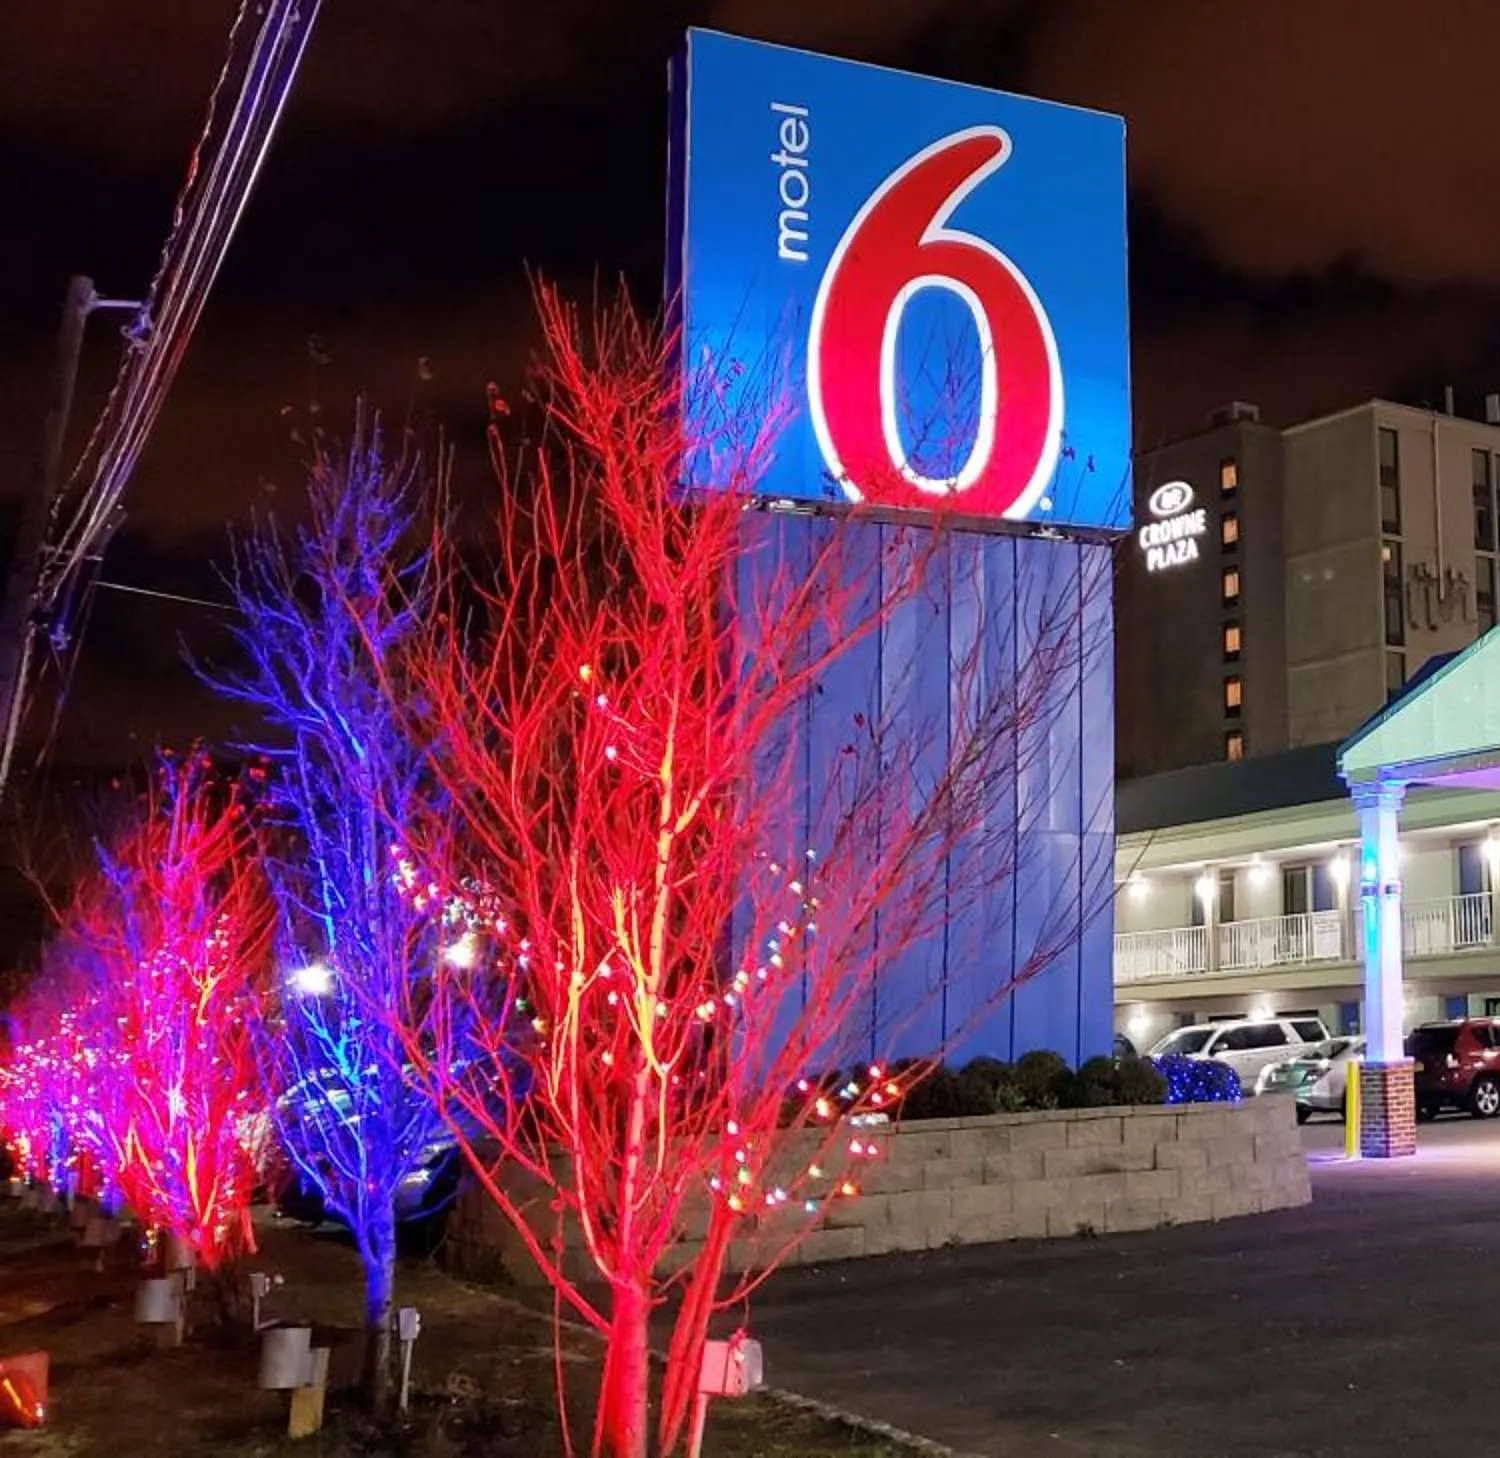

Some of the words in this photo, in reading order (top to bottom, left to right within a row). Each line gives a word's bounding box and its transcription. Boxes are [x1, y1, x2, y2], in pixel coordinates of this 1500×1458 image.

[770, 102, 809, 262] motel
[807, 125, 1064, 519] 6
[1140, 509, 1206, 550] CROWNE
[1147, 537, 1199, 572] PLAZA
